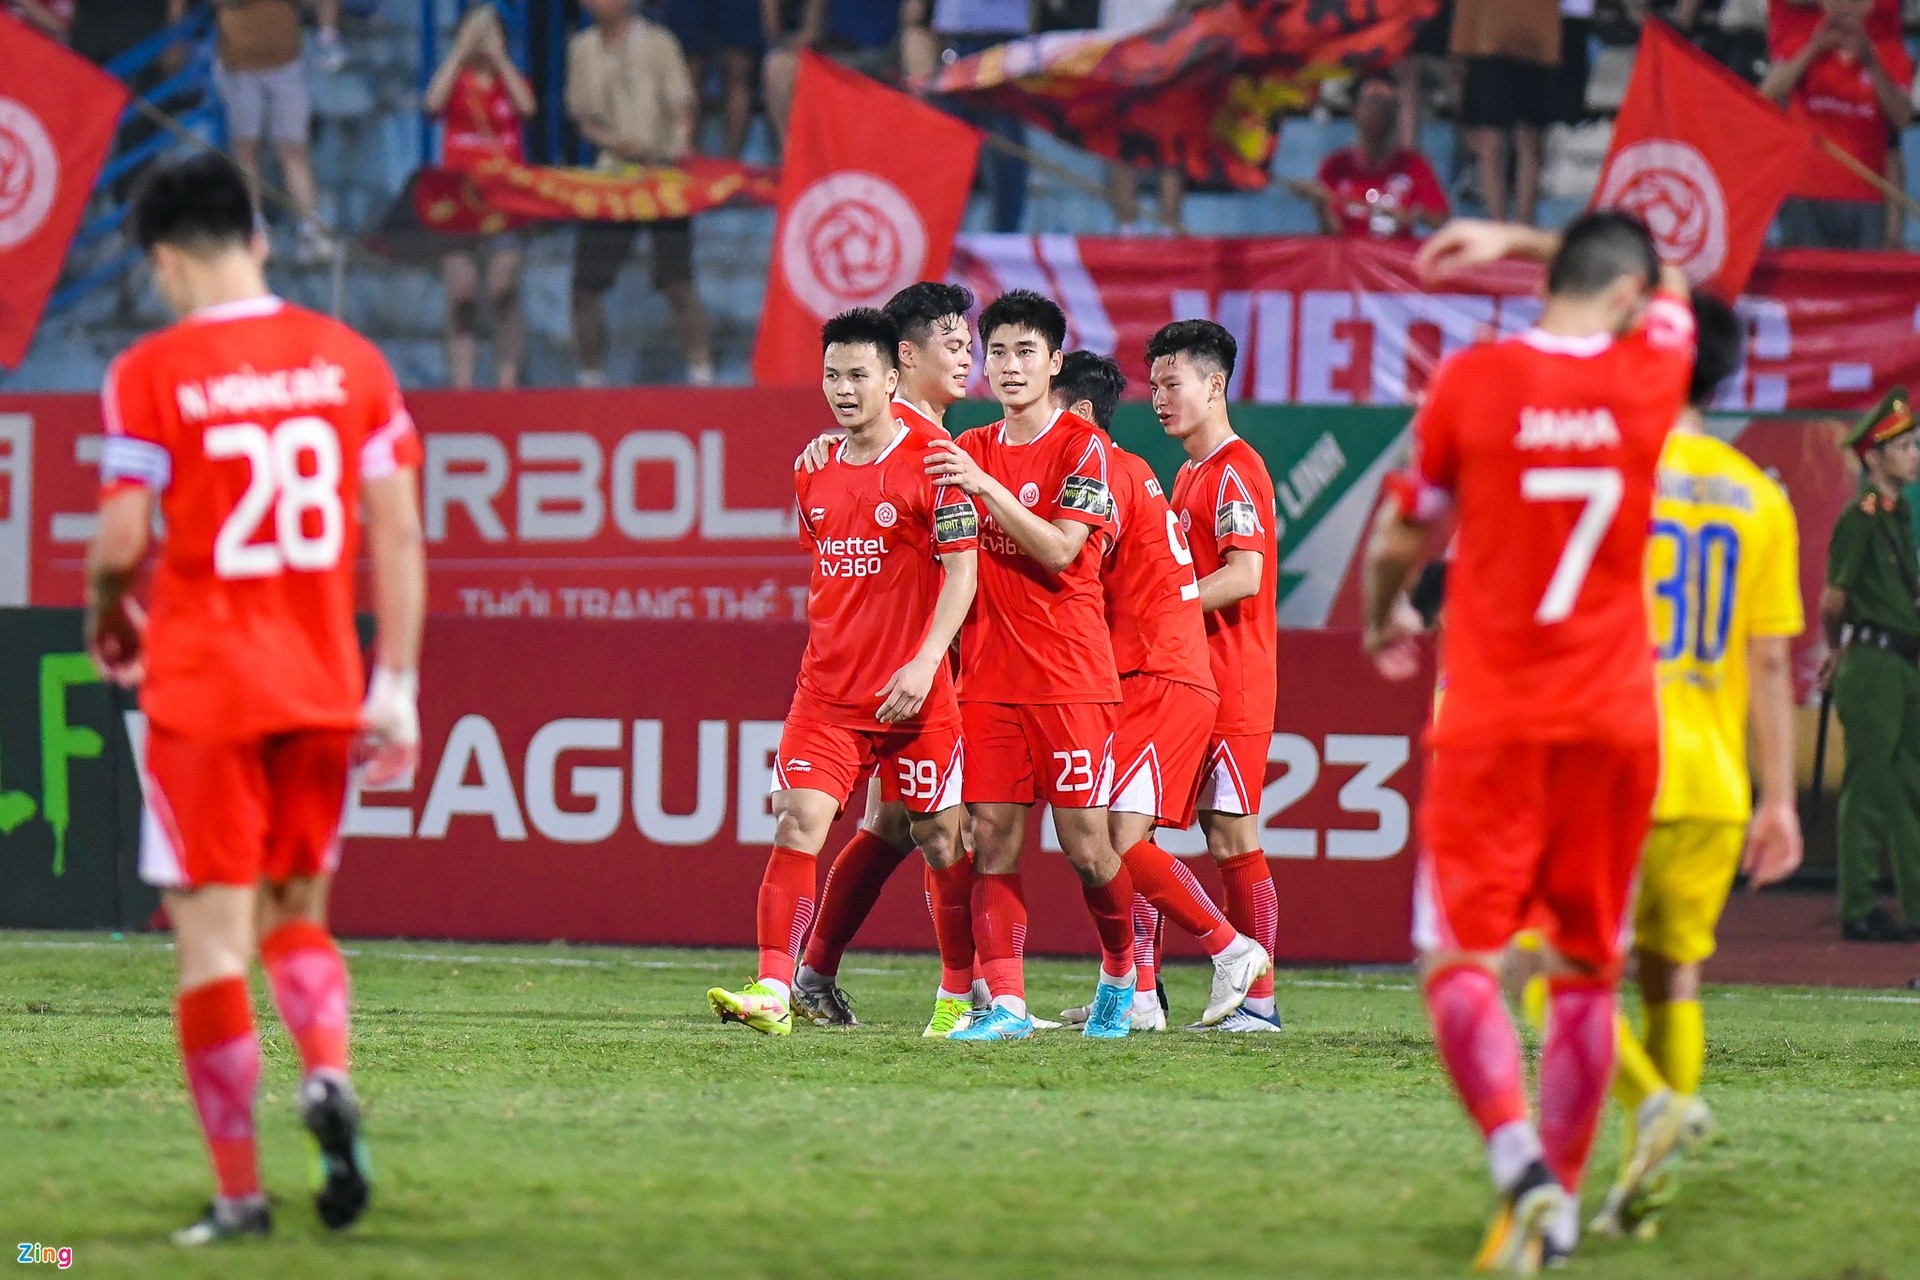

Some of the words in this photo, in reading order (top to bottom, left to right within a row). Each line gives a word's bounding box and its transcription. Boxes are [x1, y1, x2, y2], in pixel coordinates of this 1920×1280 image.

[1173, 289, 1546, 404] VIETT
[203, 416, 344, 580] 28
[815, 535, 890, 557] viettel
[936, 518, 959, 533] NIGHT
[1519, 466, 1625, 627] 7
[819, 556, 882, 579] tv360
[1648, 518, 1739, 662] 30
[897, 756, 938, 799] 39
[1052, 748, 1094, 792] 23
